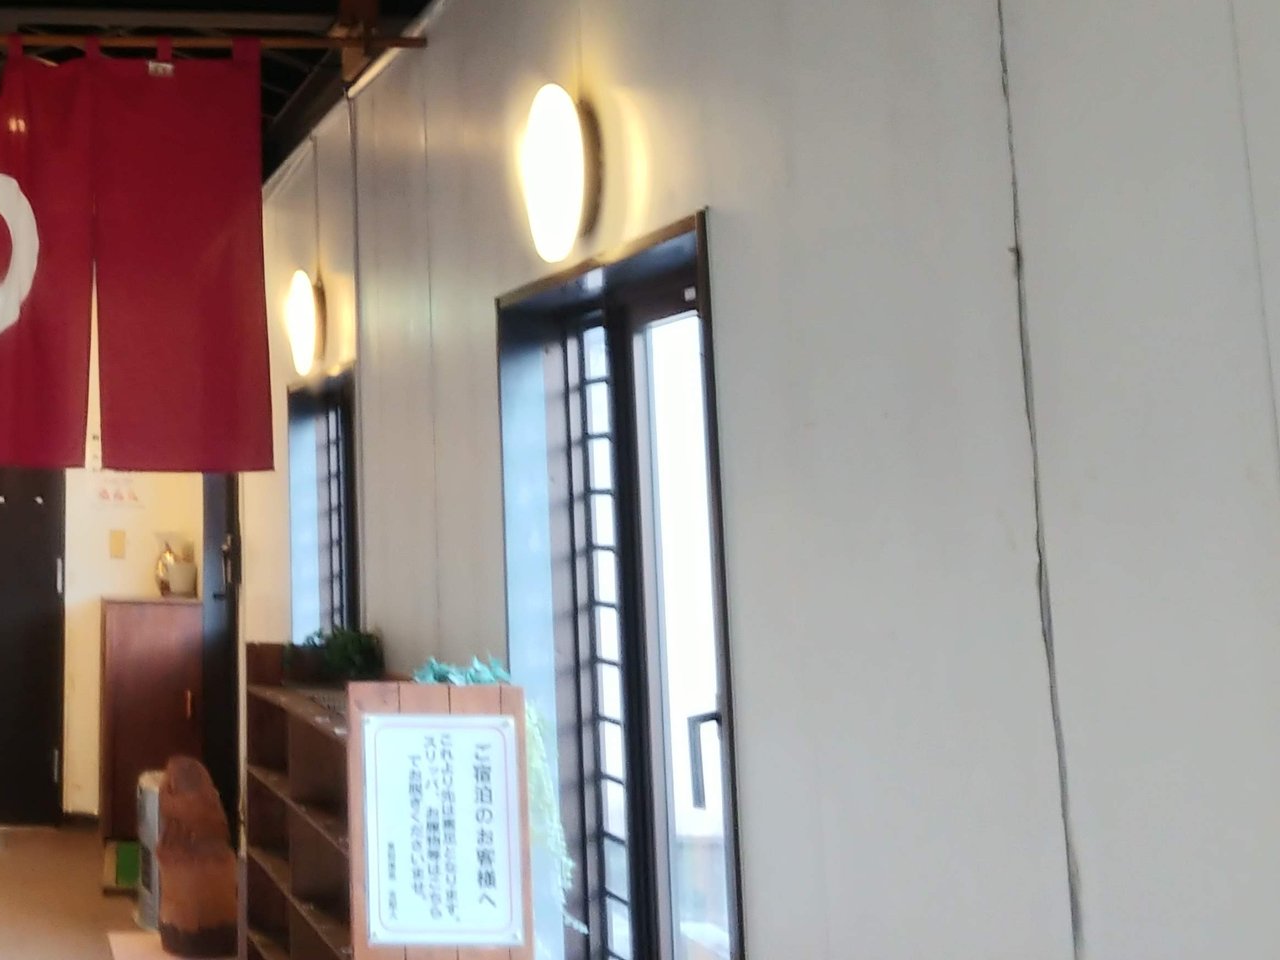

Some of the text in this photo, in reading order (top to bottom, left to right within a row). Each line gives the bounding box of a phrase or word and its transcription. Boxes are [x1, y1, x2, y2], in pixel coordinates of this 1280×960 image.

[473, 743, 497, 908] ご宿泊のお客様へ
